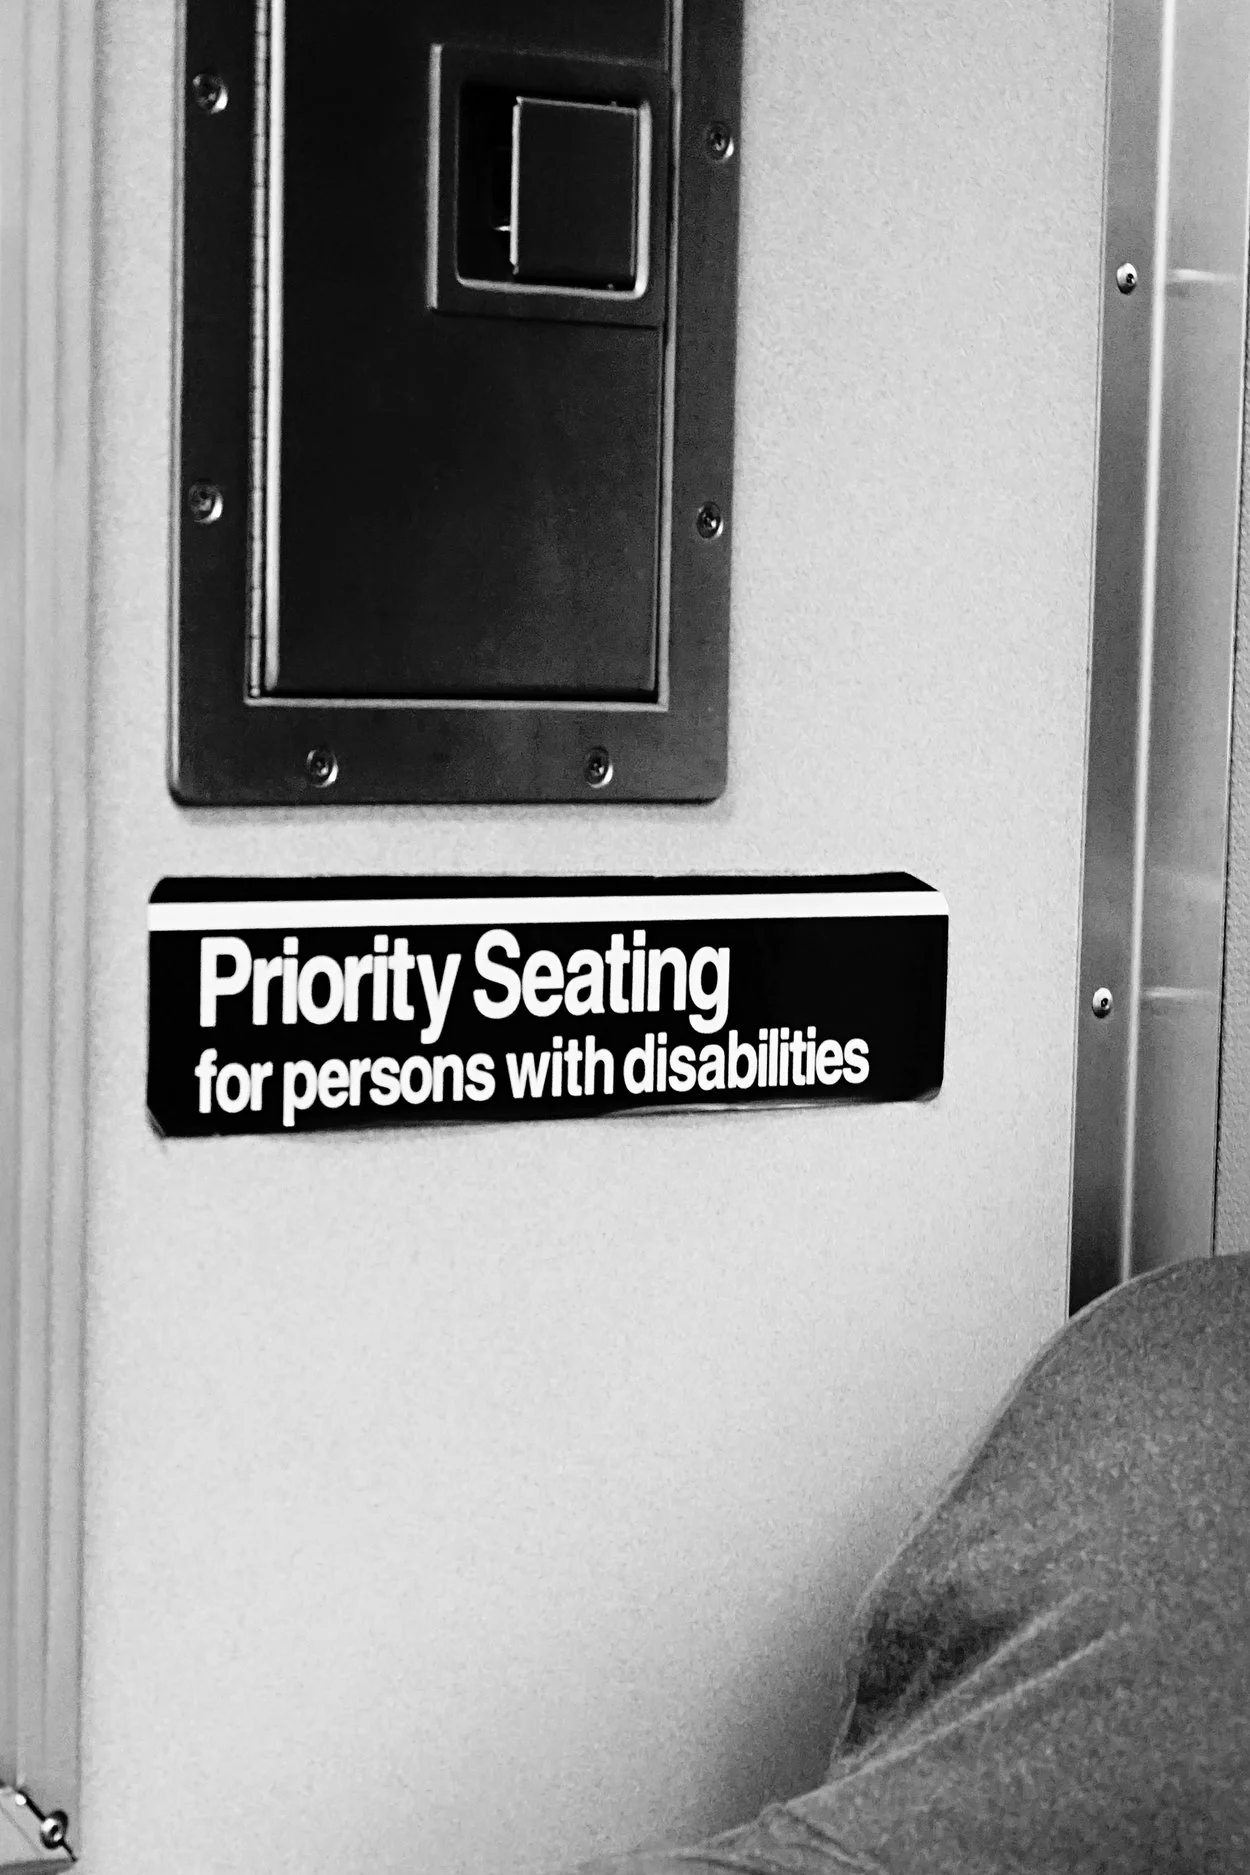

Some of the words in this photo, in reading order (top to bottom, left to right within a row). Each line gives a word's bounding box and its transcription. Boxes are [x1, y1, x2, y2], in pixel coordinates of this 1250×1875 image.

[199, 934, 462, 1045] Priority
[472, 928, 731, 1034] Seating
[194, 1047, 274, 1114] for
[282, 1051, 496, 1128] persons
[505, 1034, 615, 1099] with
[623, 1026, 870, 1095] disabilities
